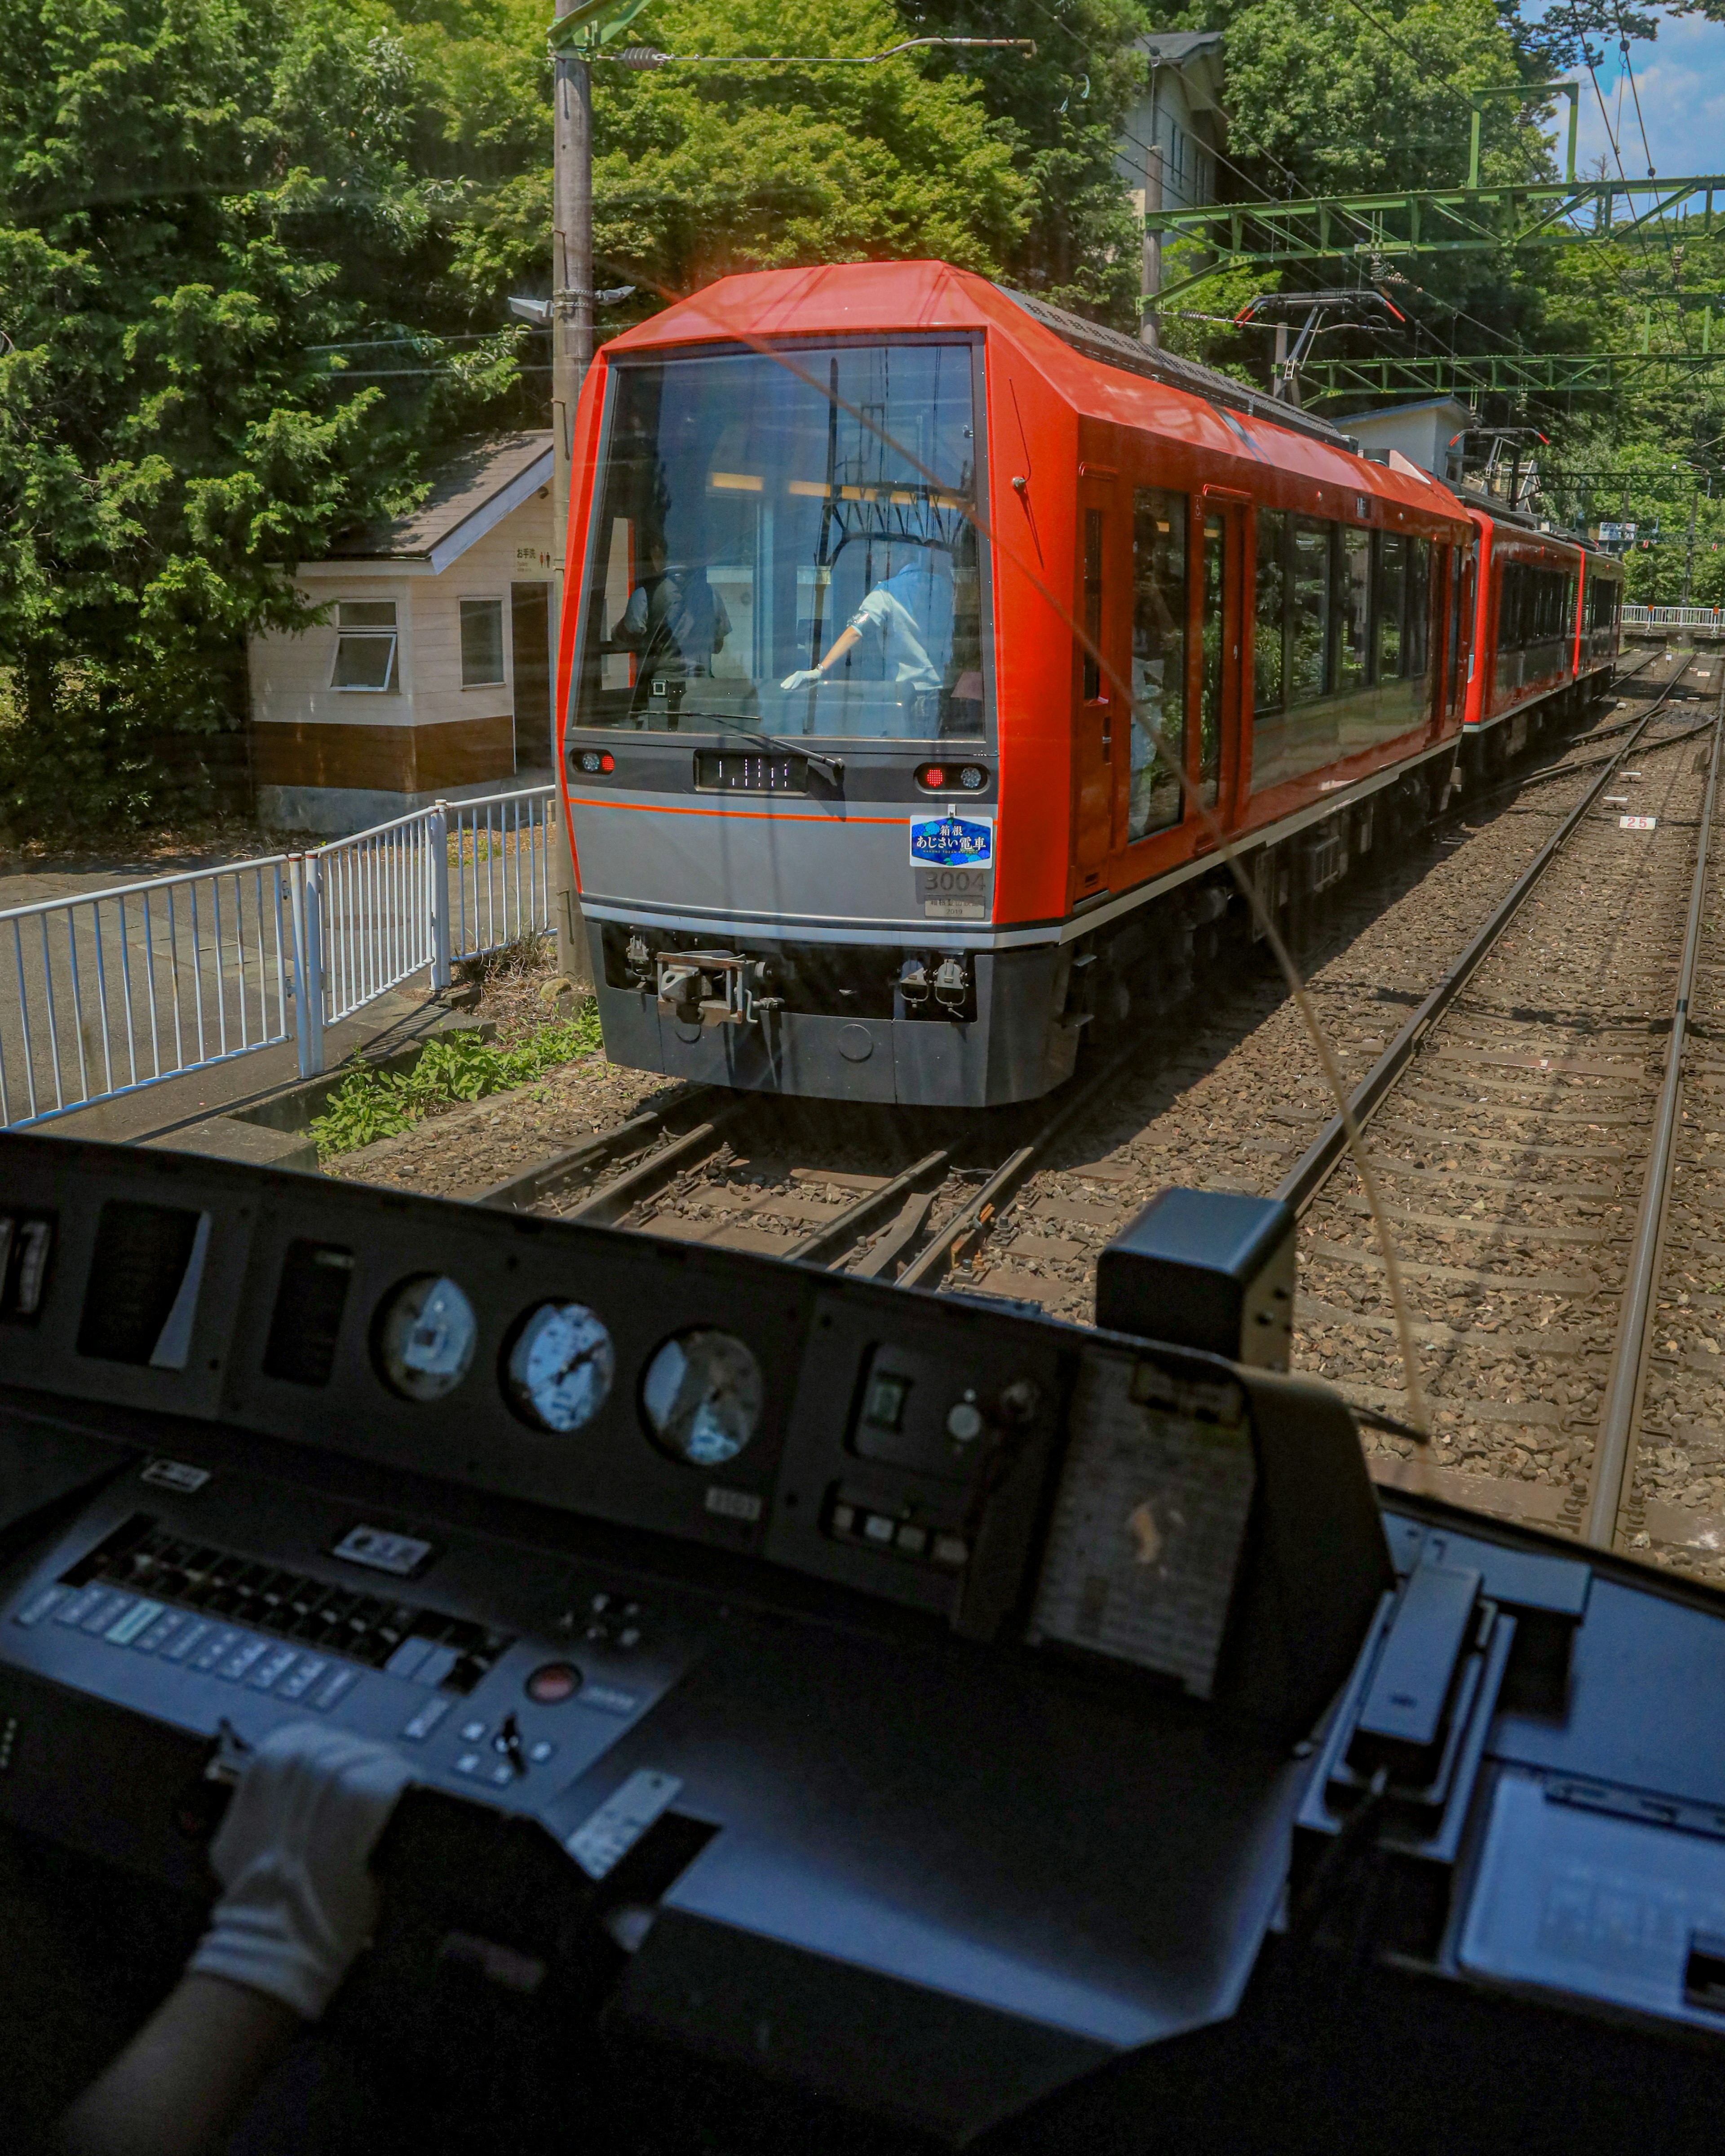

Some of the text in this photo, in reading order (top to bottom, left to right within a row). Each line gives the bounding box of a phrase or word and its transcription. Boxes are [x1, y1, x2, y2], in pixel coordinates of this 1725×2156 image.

[517, 548, 536, 558] お手洗
[1627, 817, 1647, 828] 25
[939, 825, 963, 836] 箱根
[916, 836, 986, 850] あじさい電車
[925, 871, 986, 891] 3004
